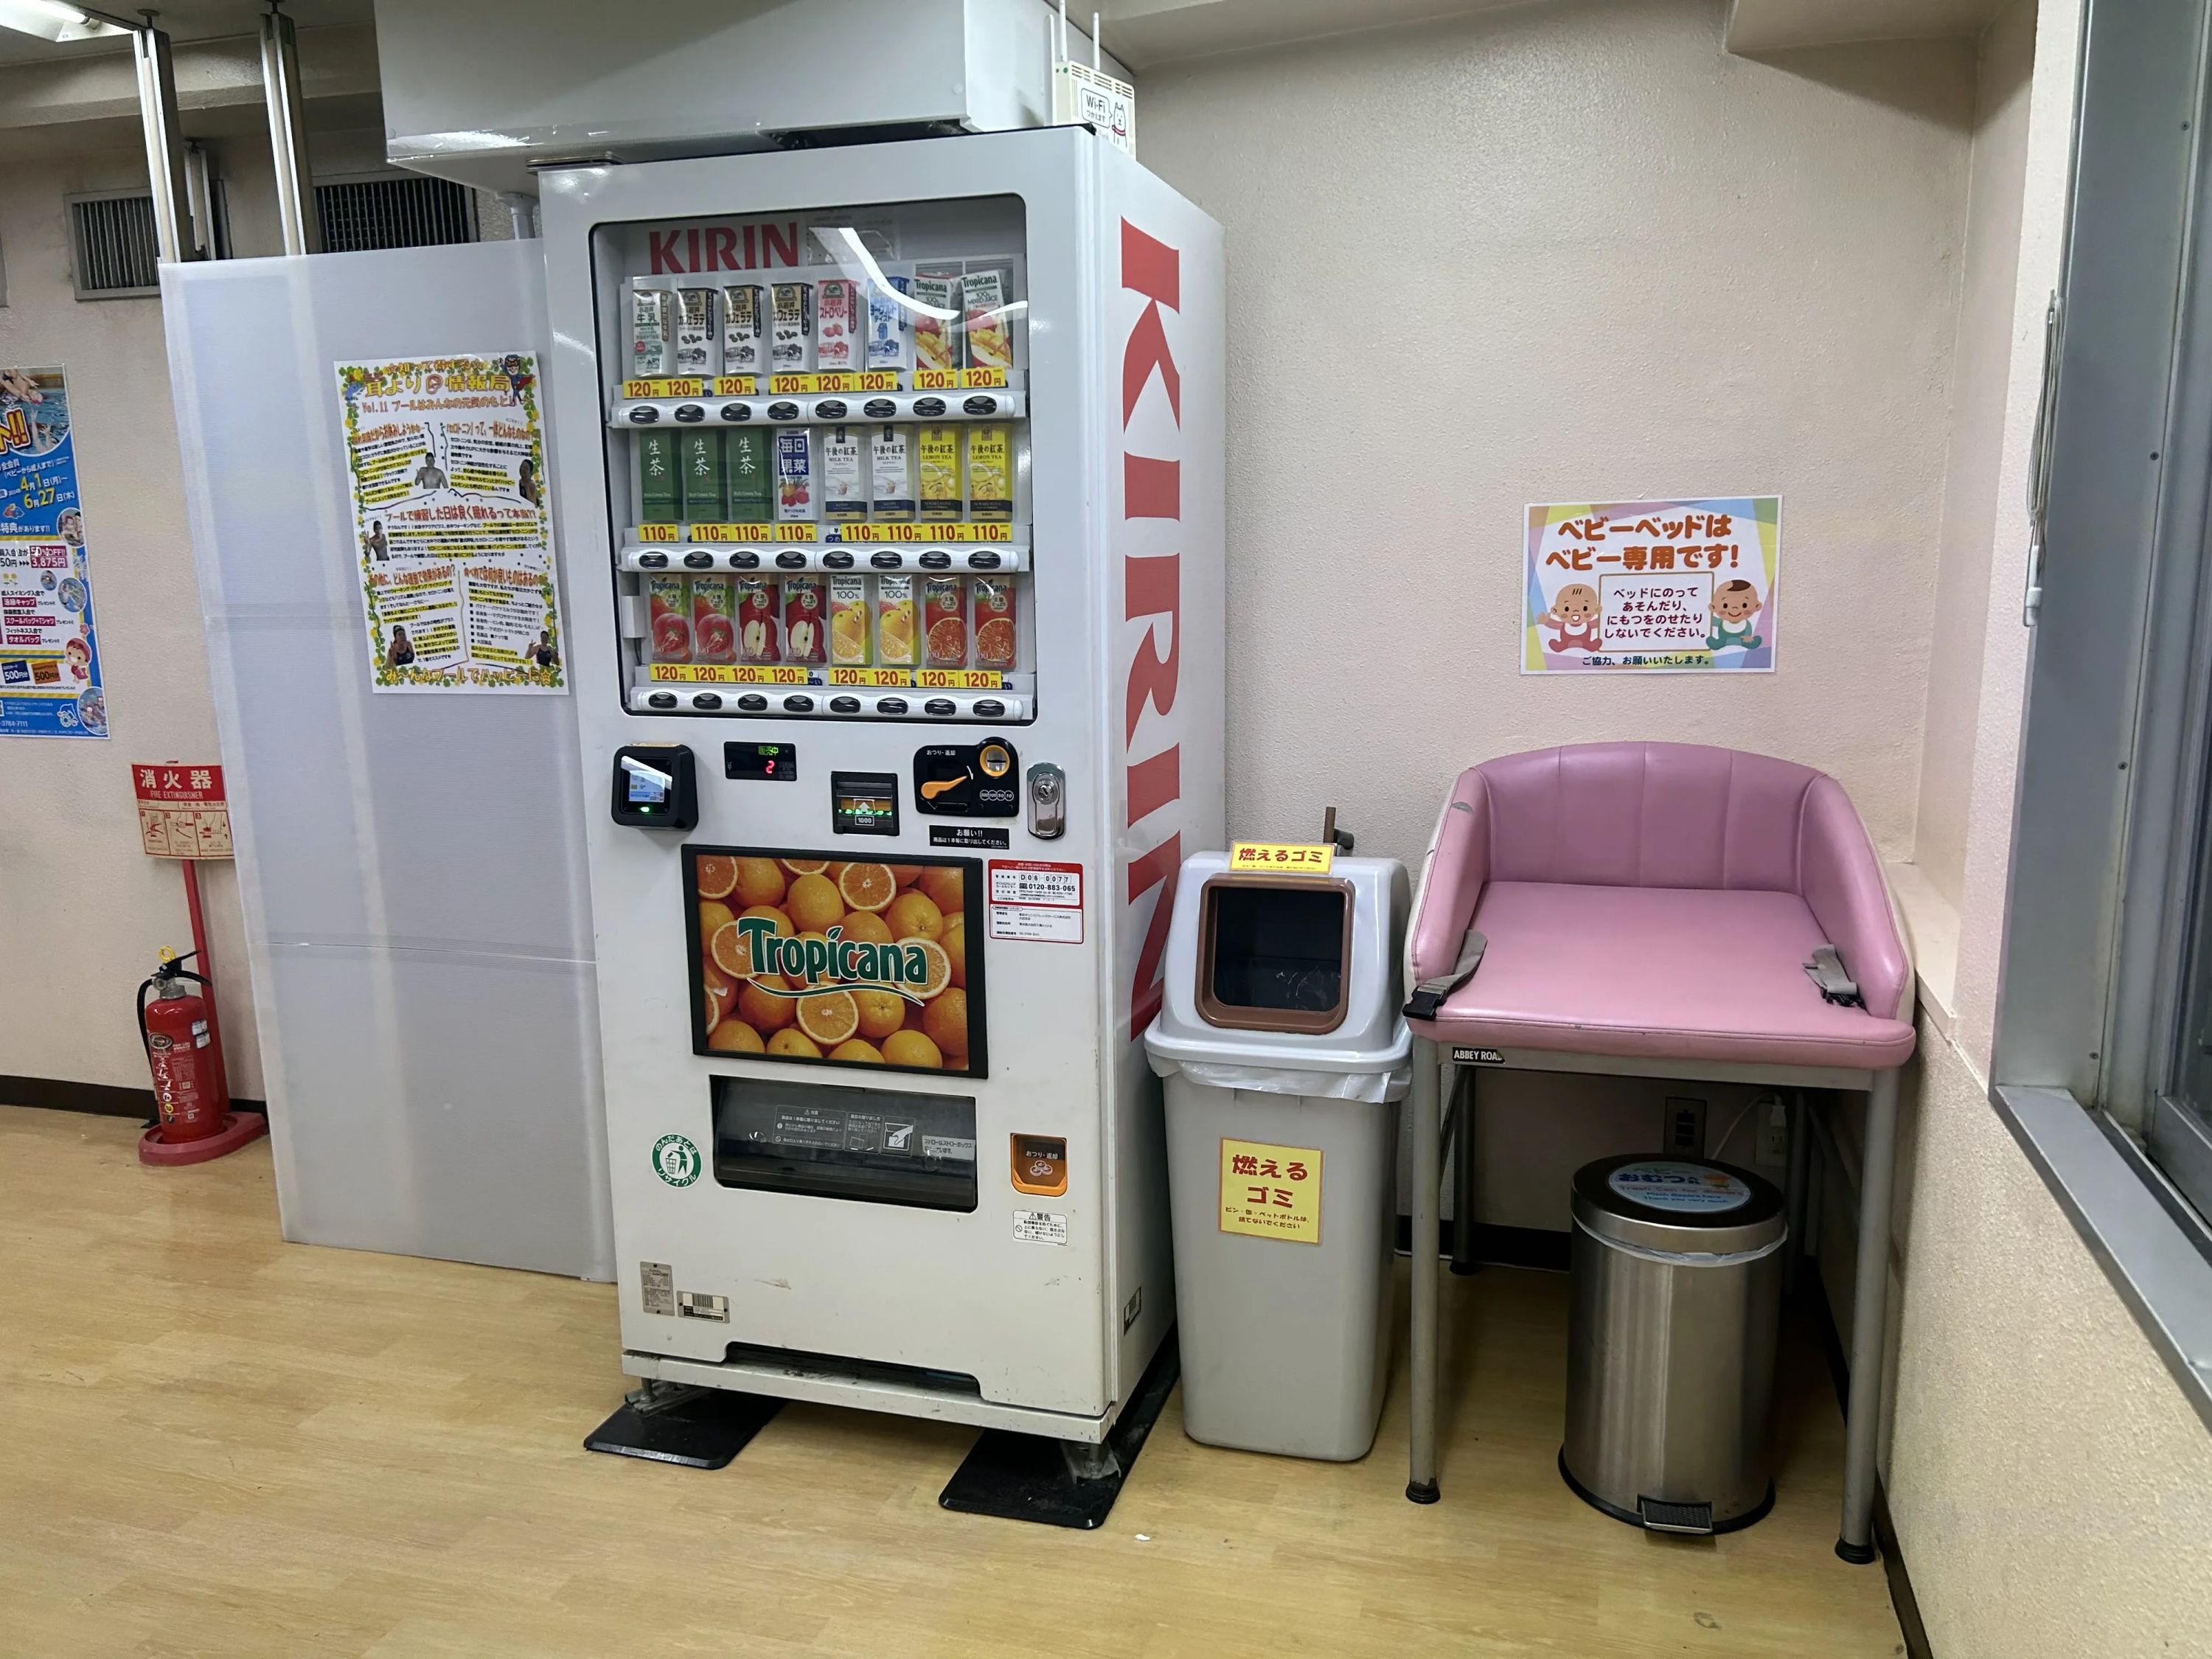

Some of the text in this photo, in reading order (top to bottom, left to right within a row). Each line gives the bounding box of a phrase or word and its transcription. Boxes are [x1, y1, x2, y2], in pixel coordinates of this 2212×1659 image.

[1086, 94, 1105, 114] Wi-Fi
[650, 223, 799, 275] KIRIN
[914, 278, 947, 293] Tropicana
[961, 274, 998, 288] Tropicana
[636, 313, 657, 322] 牛乳
[819, 307, 847, 319] ストロベリー
[445, 374, 510, 392] 情報局
[775, 377, 807, 392] 120円
[816, 375, 850, 391] 120円
[859, 373, 893, 389] 120円
[919, 372, 954, 388] 120円
[967, 369, 1001, 386] 120円
[627, 380, 659, 397] 120円
[667, 380, 699, 396] 120円
[719, 378, 751, 394] 120円
[739, 437, 756, 474] 生茶
[826, 446, 858, 456] 午後の紅茶
[874, 445, 905, 454] 午後の紅茶
[921, 444, 954, 454] 午後の紅茶
[970, 444, 1004, 454] 午後の紅茶
[648, 439, 664, 476] 生茶
[694, 439, 710, 476] 生茶
[24, 487, 75, 509] 6月27日(木)
[643, 526, 675, 540] 110円
[695, 526, 728, 540] 110円
[735, 526, 768, 540] 110円
[779, 526, 813, 540] 110円
[846, 525, 879, 540] 110円
[888, 525, 921, 540] 110円
[930, 525, 964, 540] 110円
[973, 524, 1007, 540] 110円
[1558, 514, 1732, 540] ベビーベッドは
[32, 557, 66, 568] 3,875円
[1545, 543, 1739, 571] ベビー専用です!
[650, 578, 680, 591] Tropicana
[695, 578, 724, 591] Tropicana
[739, 577, 767, 591] Tropicana
[787, 578, 817, 591] Tropicana
[832, 575, 862, 586] Tropicana
[927, 582, 957, 594] Tropicana
[836, 591, 860, 599] 100%
[885, 591, 908, 599] 100%
[1613, 586, 1699, 599] ベッドにのって
[1622, 601, 1688, 613] あそんだり、
[1607, 613, 1703, 625] にもつをのせたり
[1121, 216, 1180, 1041] KIRIN
[1604, 627, 1706, 639] しないでください。
[655, 666, 686, 681] 120円
[693, 667, 725, 681] 120円
[732, 667, 765, 682] 120円
[772, 669, 804, 684] 120円
[834, 669, 866, 684] 120円
[874, 670, 907, 686] 120円
[922, 672, 956, 687] 120円
[964, 672, 998, 688] 120円
[766, 760, 775, 773] 2
[140, 769, 212, 789] 消火器
[150, 790, 204, 799] FIRE EXTINGUISHER
[956, 829, 983, 837] お願い!!
[1239, 848, 1323, 863] 燃えるゴミ
[1029, 883, 1076, 891] 0120-883-065
[737, 917, 928, 985] Tropicana
[1453, 1049, 1479, 1060] ABBEY
[655, 1135, 698, 1155] のんだあとは
[1026, 1150, 1059, 1160] おつり・返却
[1232, 1154, 1308, 1181] 燃える
[657, 1168, 697, 1186] リサイクル
[1618, 1173, 1686, 1183] おむつ
[1247, 1186, 1293, 1208] ゴミ
[1238, 1216, 1301, 1229] 捨てないでください
